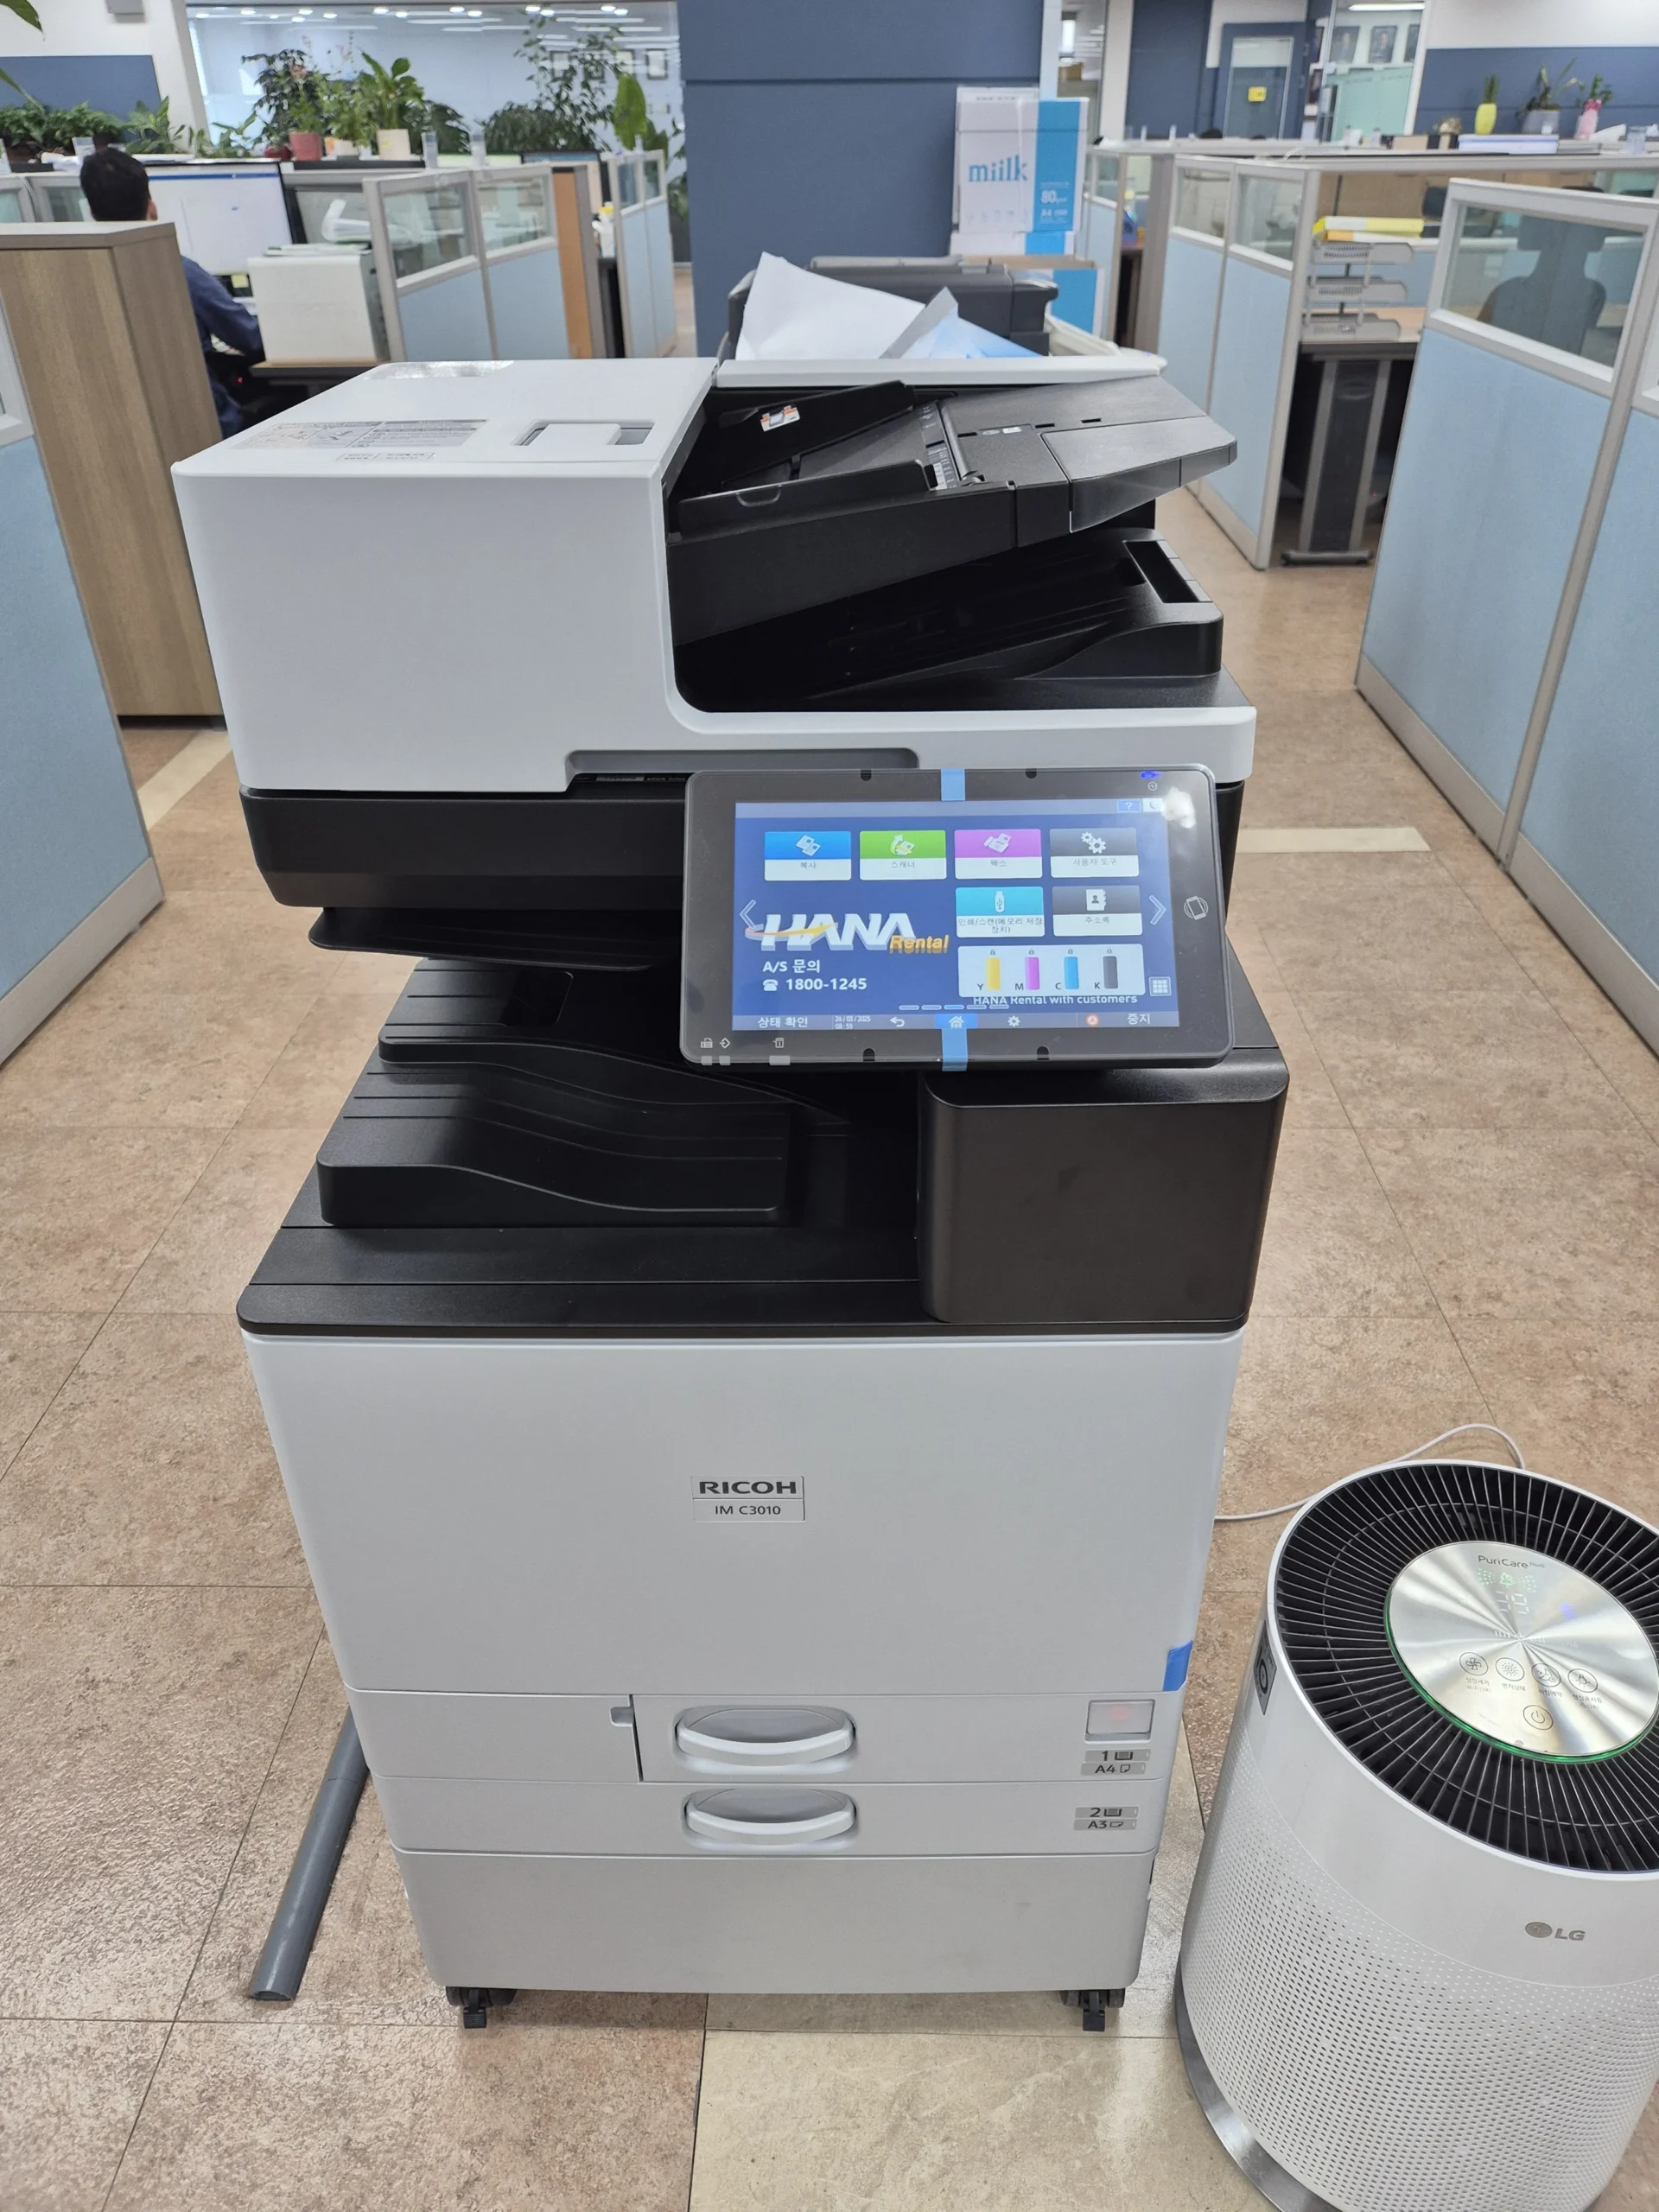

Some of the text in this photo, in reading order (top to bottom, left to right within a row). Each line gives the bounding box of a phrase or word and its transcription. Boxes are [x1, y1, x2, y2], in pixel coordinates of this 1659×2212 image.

[968, 154, 1027, 182] miilk
[800, 861, 817, 869] 복사
[891, 861, 915, 869] 스캐너
[1072, 858, 1098, 867] 사용자
[1026, 917, 1043, 925] 저장
[760, 912, 917, 951] HANA
[889, 934, 950, 953] Rental
[762, 959, 821, 974] A/S 문의
[785, 977, 867, 991] 1800-1245
[973, 995, 1138, 1005] HANA Rental with customers
[757, 1016, 808, 1028] 상태 확인
[1127, 1014, 1151, 1025] 중지
[699, 1481, 797, 1495] RICOH
[715, 1505, 781, 1516] IM C3010
[1478, 1554, 1529, 1569] PuriCare
[1102, 1751, 1109, 1762] 1
[1094, 1764, 1116, 1774] A4
[1090, 1808, 1101, 1817] 2
[1087, 1821, 1107, 1829] A3
[1554, 1928, 1586, 1942] LG
